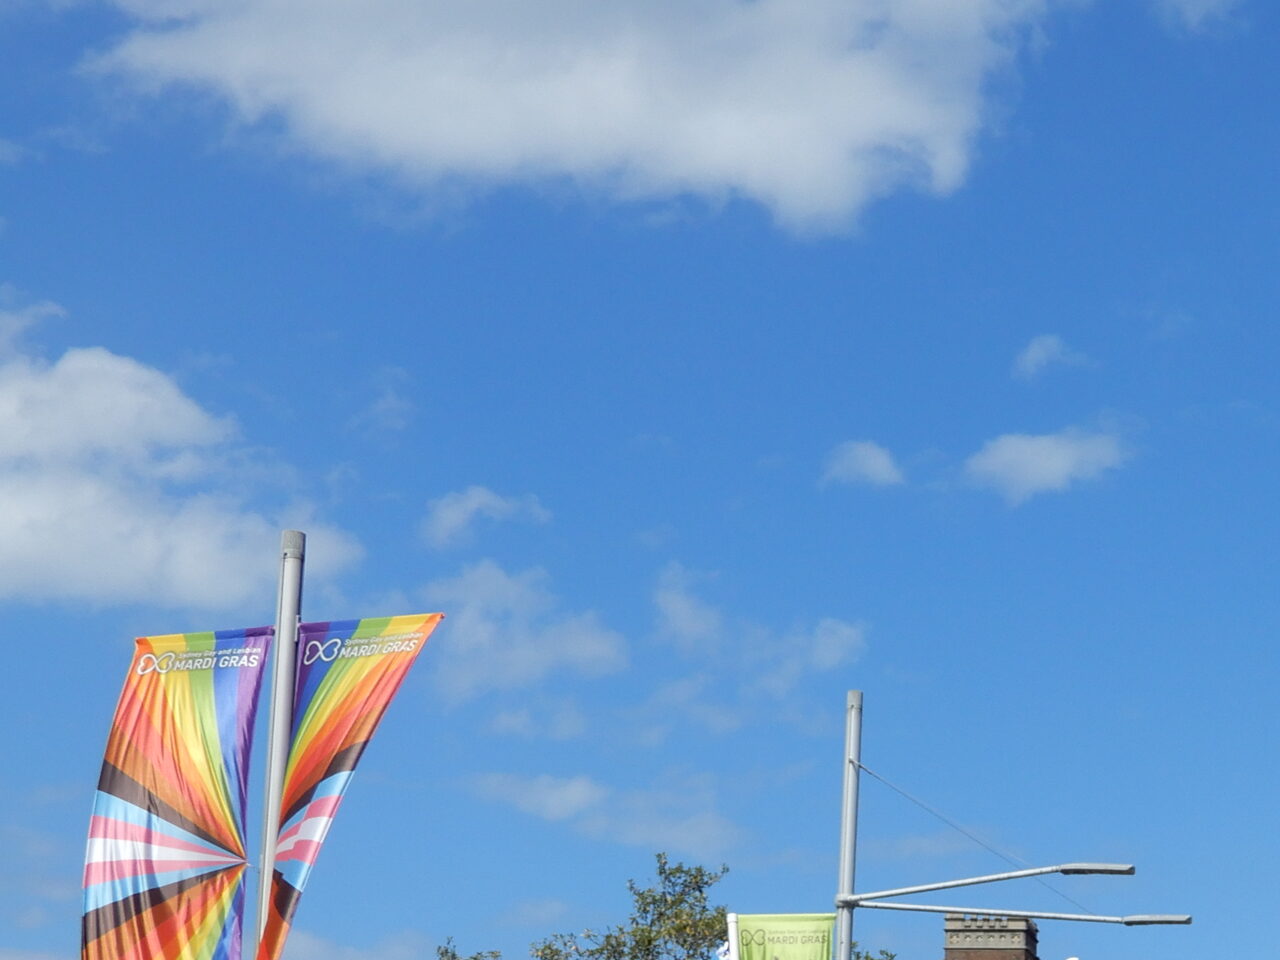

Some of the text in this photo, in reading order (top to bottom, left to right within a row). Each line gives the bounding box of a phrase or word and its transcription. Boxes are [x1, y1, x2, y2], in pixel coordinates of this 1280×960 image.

[338, 639, 418, 659] MARDI GRAS
[174, 654, 259, 671] MARDI GRAS
